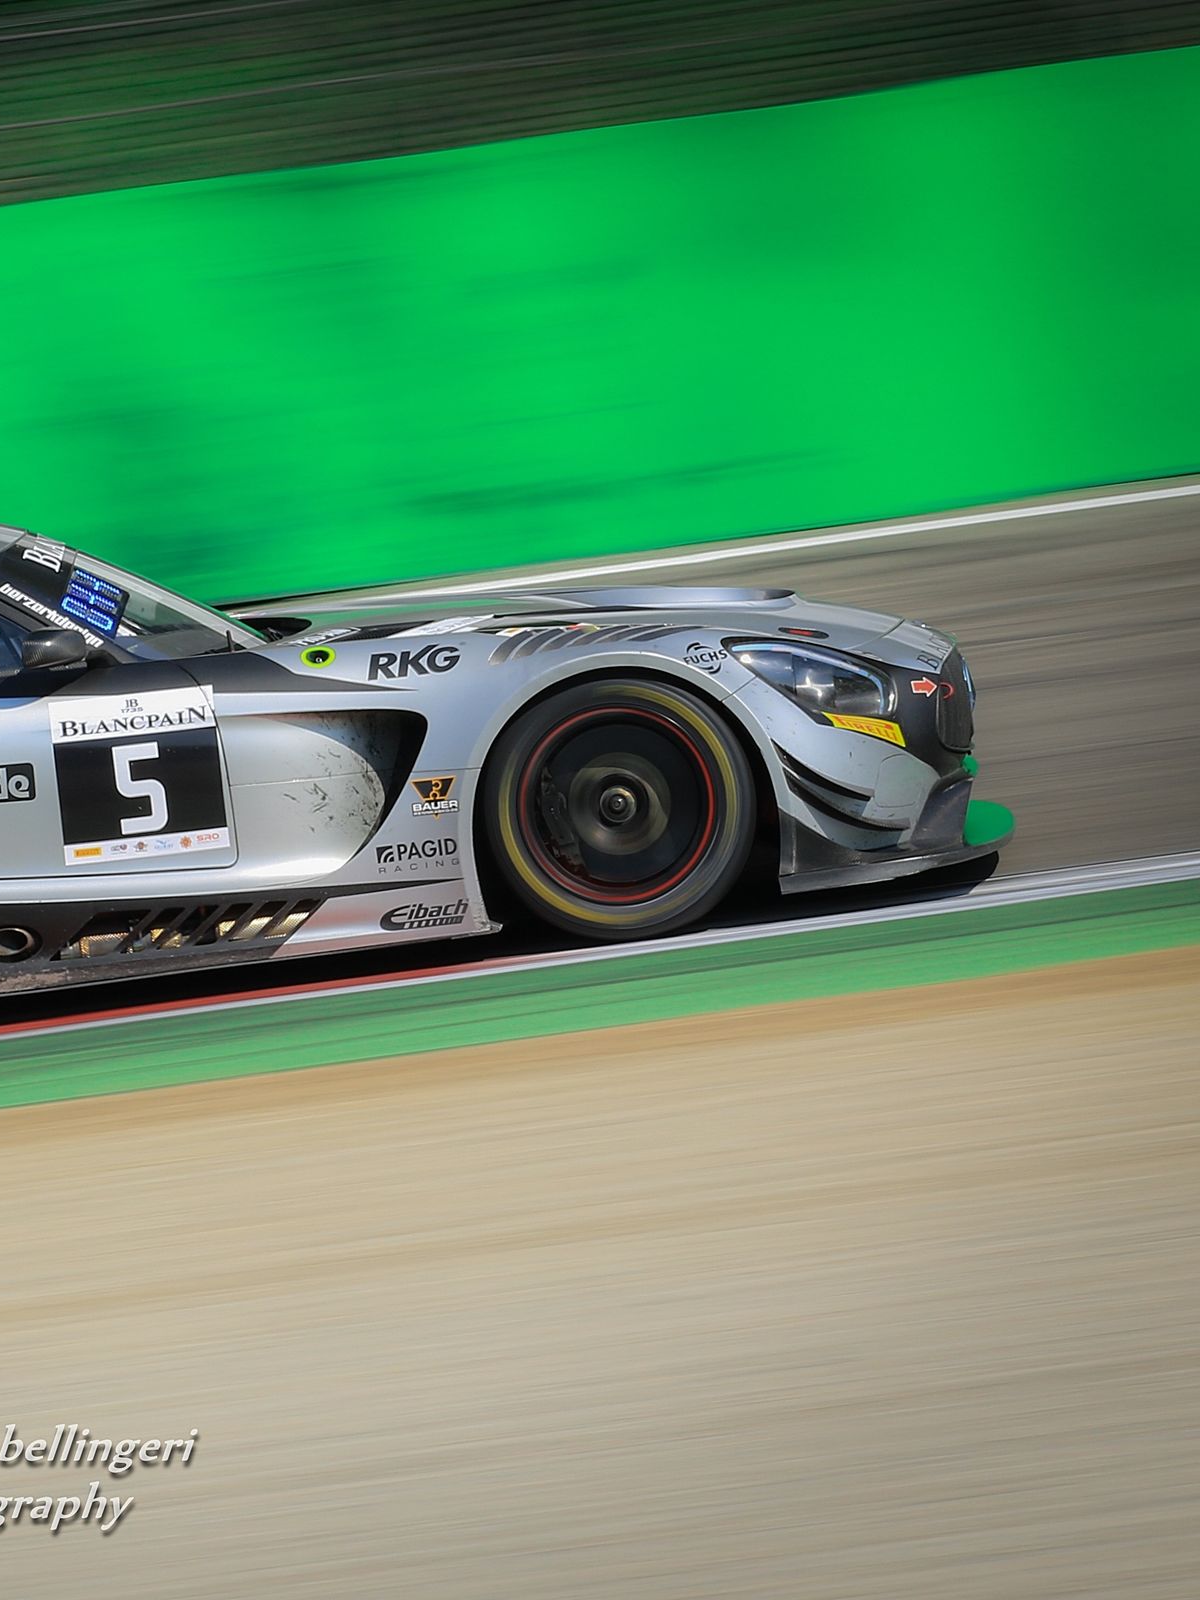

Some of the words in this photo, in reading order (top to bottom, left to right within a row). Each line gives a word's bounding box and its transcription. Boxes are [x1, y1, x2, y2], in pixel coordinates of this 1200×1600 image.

[367, 644, 461, 681] RKG
[682, 649, 728, 665] FUCHS
[59, 705, 208, 738] BLANCPAIN
[833, 715, 900, 742] PIRELLI
[111, 741, 169, 836] 5
[412, 800, 458, 812] BAUER
[396, 838, 458, 861] PAGID
[378, 858, 460, 874] RACING
[380, 898, 469, 931] Eibach
